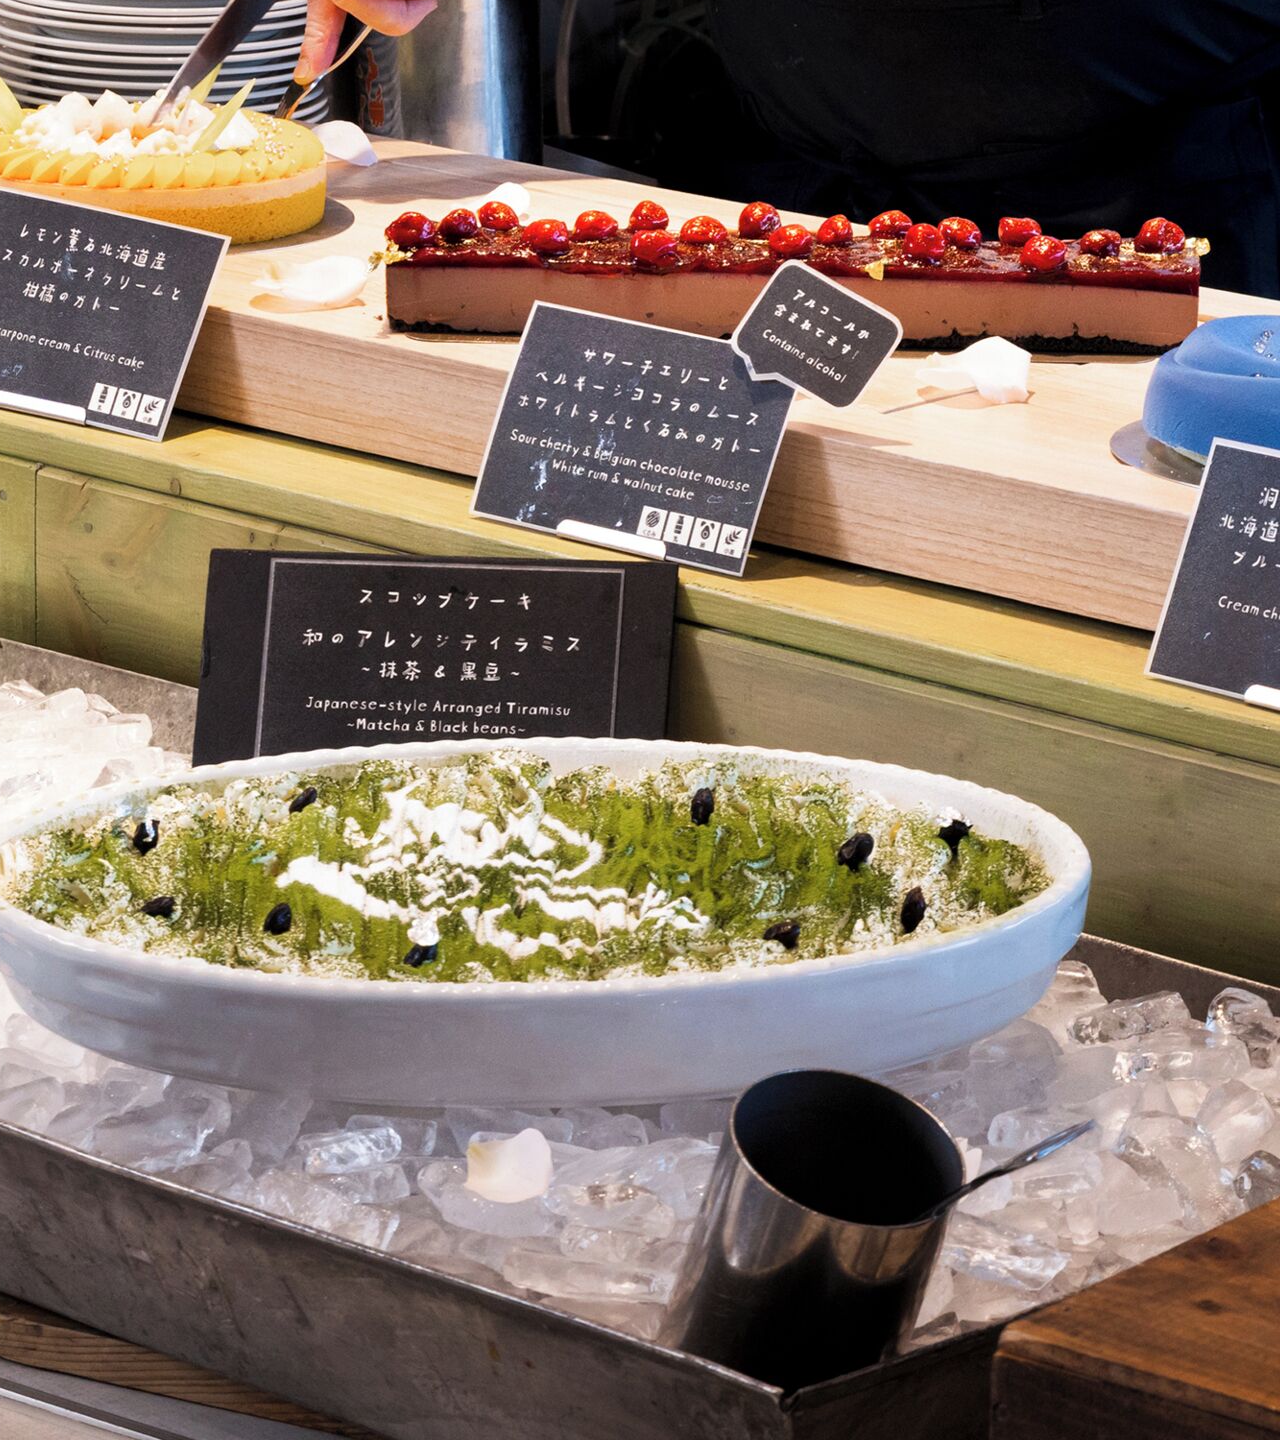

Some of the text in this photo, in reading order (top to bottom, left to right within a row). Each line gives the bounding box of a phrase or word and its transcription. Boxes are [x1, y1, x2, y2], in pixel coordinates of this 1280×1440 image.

[19, 223, 167, 271] レモン薫る北海道産
[22, 280, 121, 312] 柑橘のガトー
[792, 288, 871, 340] アルコールが
[38, 337, 71, 353] cream
[72, 342, 82, 354] &
[83, 344, 116, 362] Citrus
[118, 355, 145, 370] cake
[583, 348, 730, 391] サワーチェリーと
[762, 328, 848, 384] Contains alcohol
[535, 370, 760, 427] ベルギーショコラのムース
[517, 393, 762, 455] ホワイトラムとくるみのガトー
[510, 428, 751, 493] Sour cherry & Belgian chocolate mousse
[552, 458, 695, 501] White rum & walnut cake
[1218, 594, 1260, 617] Cream
[301, 628, 581, 653] 和のアレンジティラミス
[305, 696, 572, 717] Japanese-style Arranged Tiramisu
[414, 719, 425, 732] &
[429, 719, 469, 733] Black
